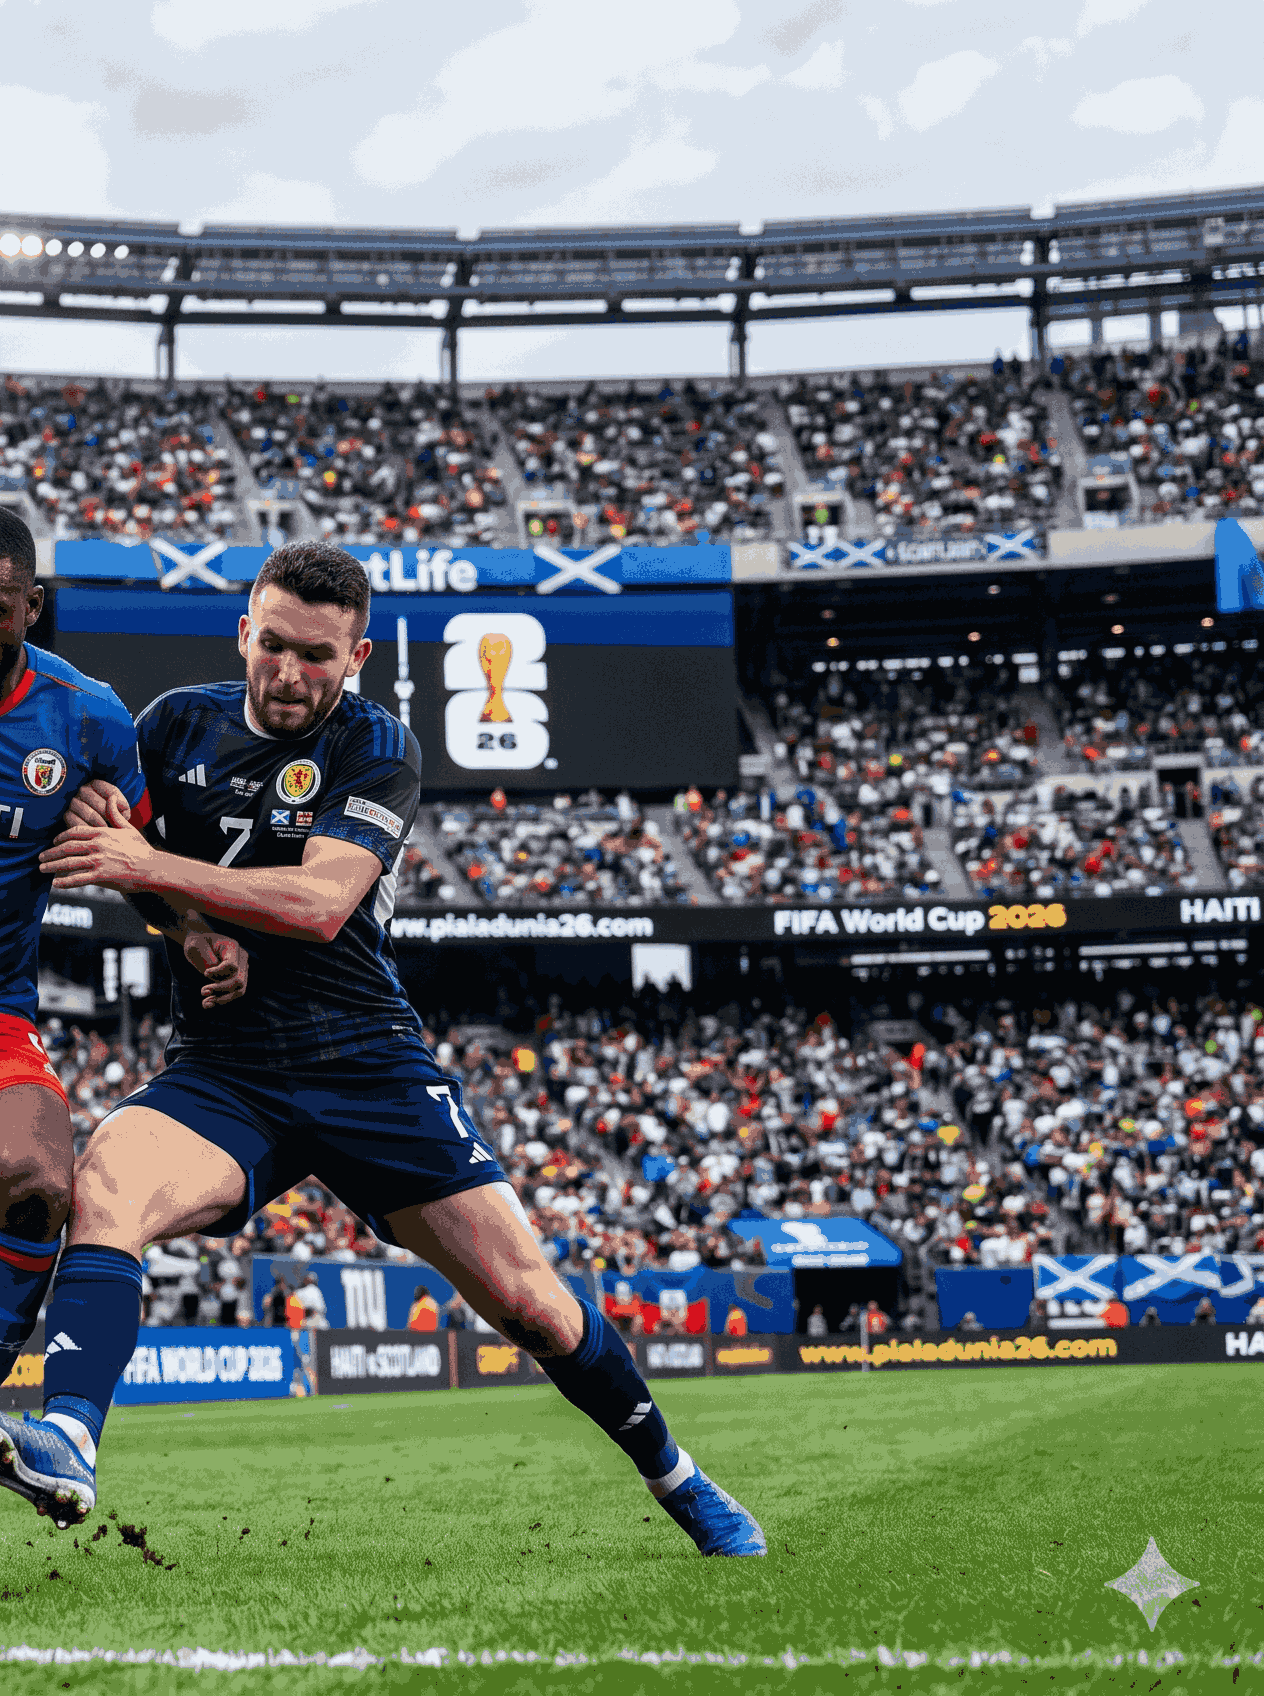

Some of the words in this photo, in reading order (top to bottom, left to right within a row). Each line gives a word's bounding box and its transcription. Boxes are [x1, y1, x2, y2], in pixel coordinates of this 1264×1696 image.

[219, 816, 254, 867] 7
[773, 909, 839, 936] FIFA
[840, 906, 925, 934] World
[927, 905, 986, 937] Cup
[987, 903, 1067, 930] 2026
[1180, 896, 1261, 924] HAITI
[426, 1085, 469, 1139] 7
